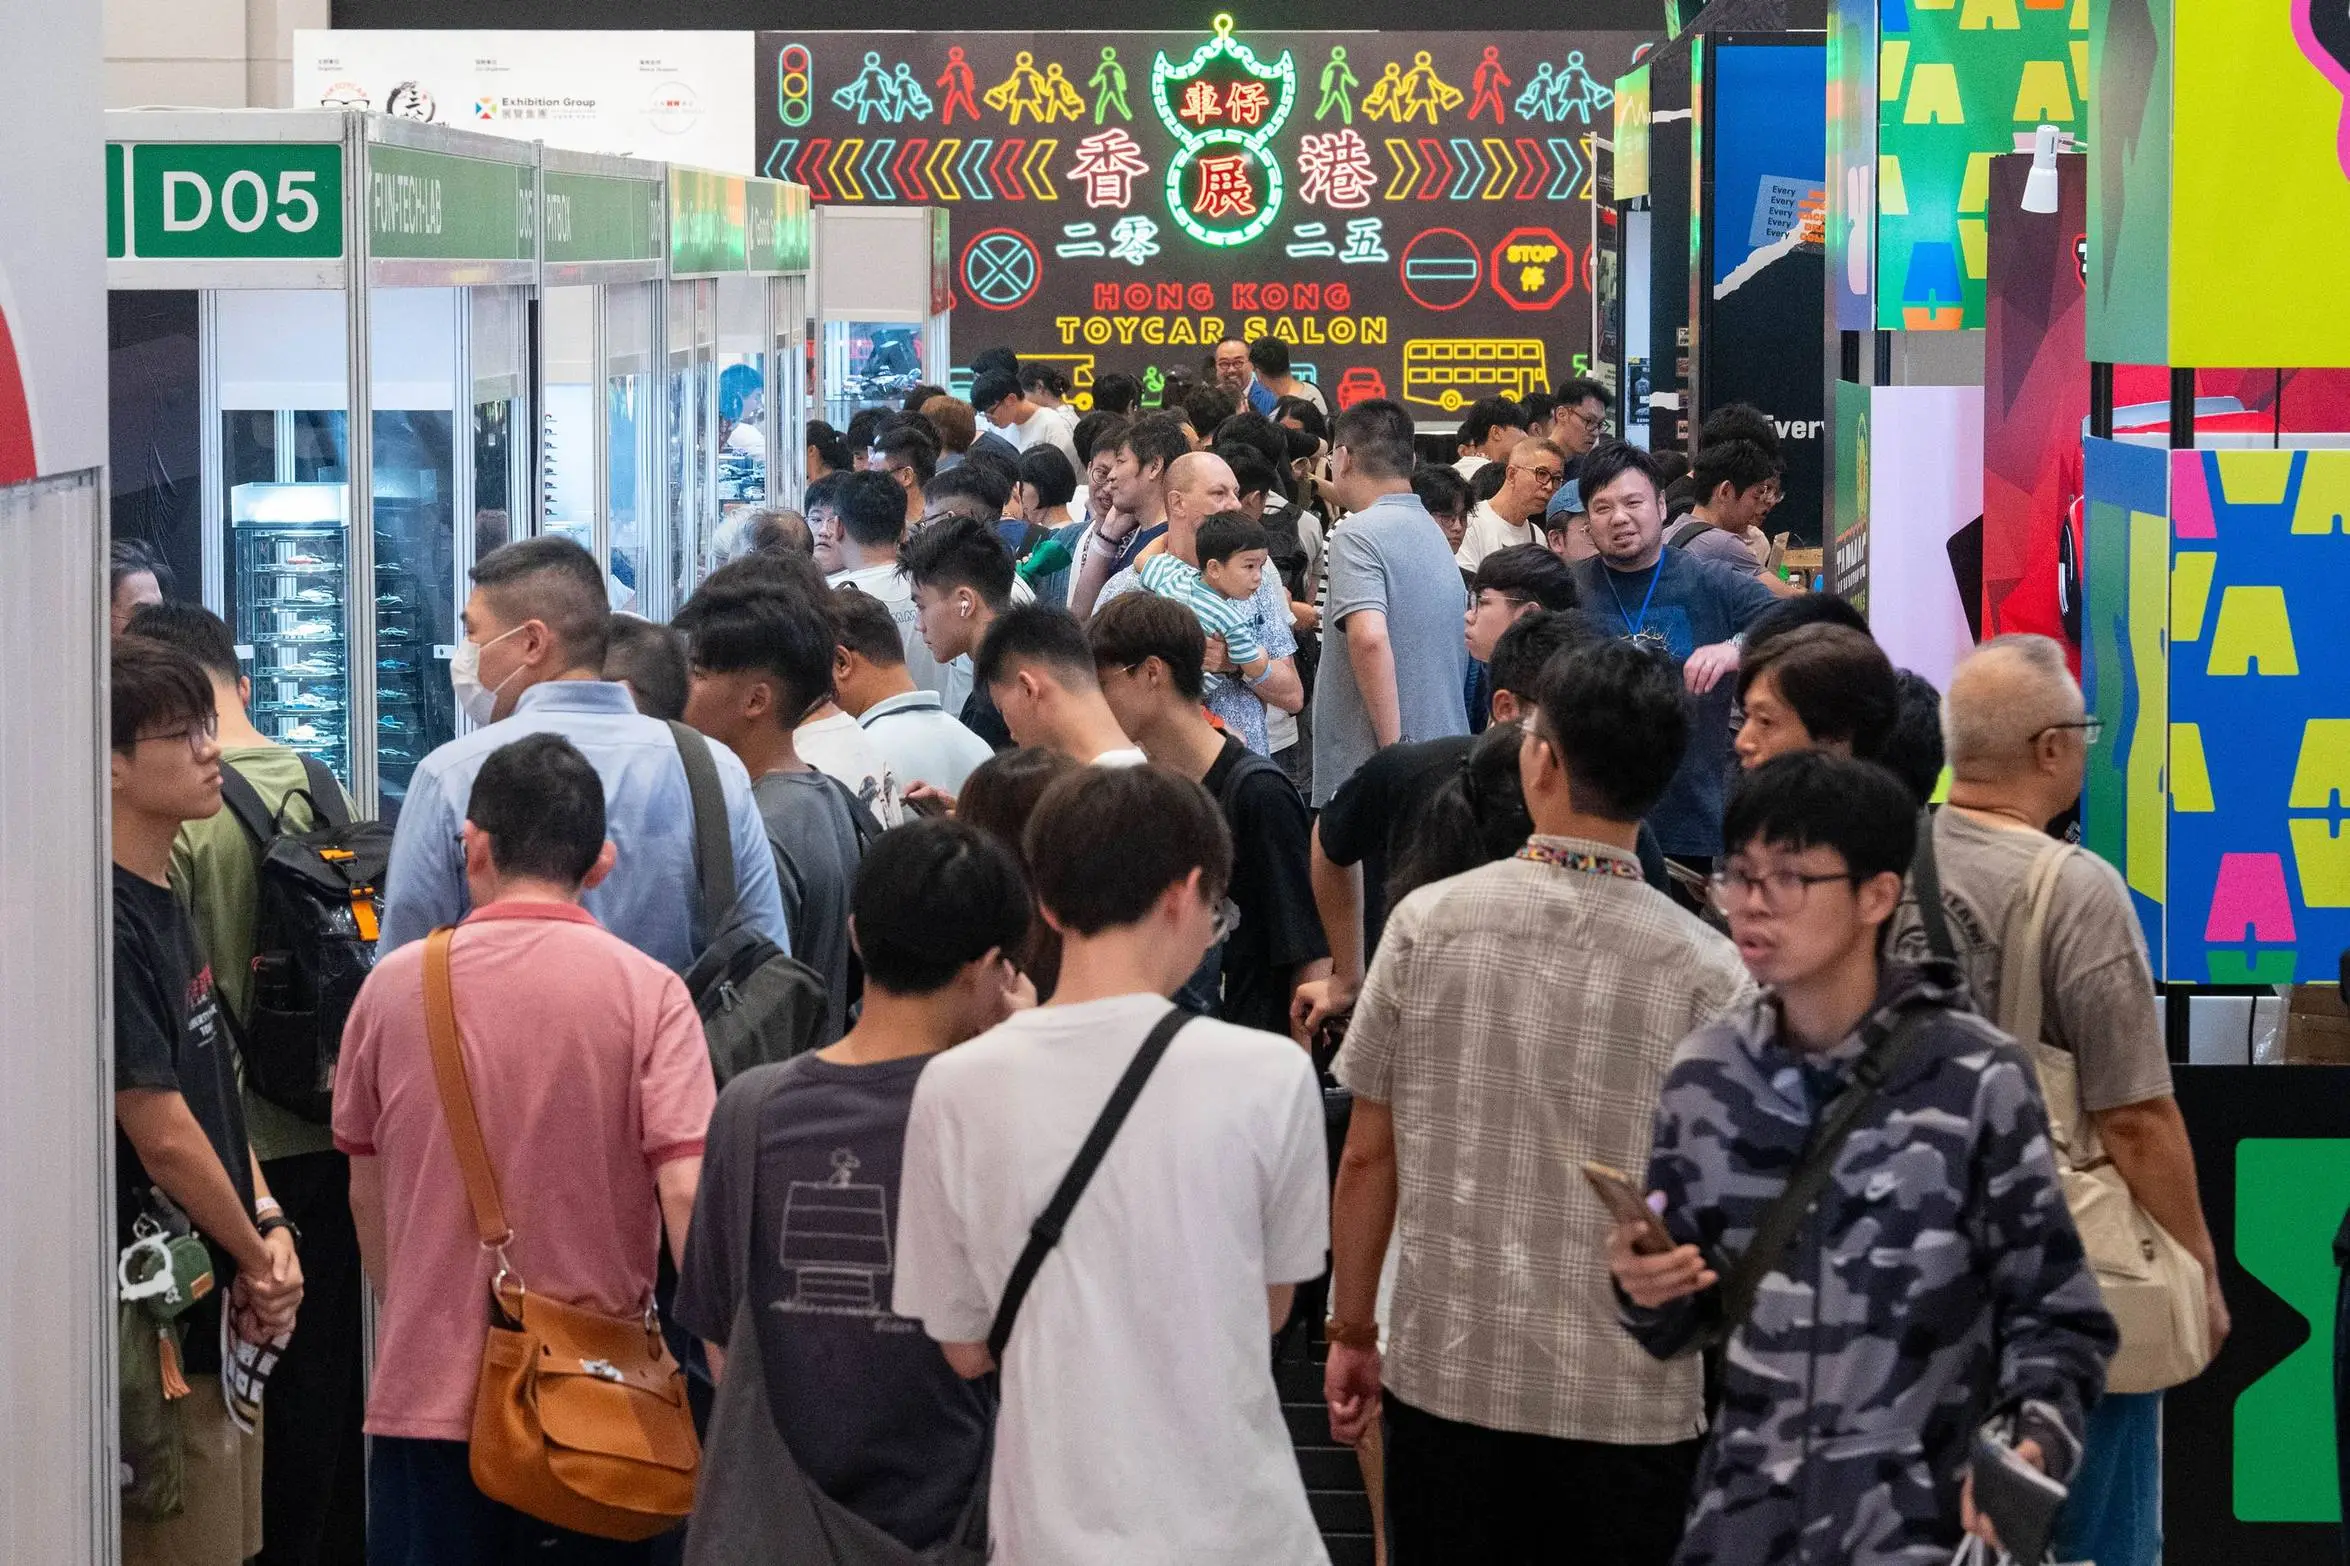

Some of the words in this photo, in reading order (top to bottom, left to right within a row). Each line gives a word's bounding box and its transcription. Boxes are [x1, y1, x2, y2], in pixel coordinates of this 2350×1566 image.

[502, 97, 560, 107] Exhibition
[563, 97, 596, 108] Group
[1180, 81, 1270, 124] 車仔
[1066, 128, 1149, 209] 香
[1297, 128, 1378, 209] 港
[1193, 155, 1256, 218] 展
[1772, 185, 1796, 197] Every
[162, 170, 319, 233] D05
[374, 173, 442, 235] FUN-TECH-LAB
[1769, 207, 1793, 218] Every
[1770, 196, 1794, 207] Every
[1766, 228, 1790, 240] Every
[1767, 217, 1791, 229] Every
[1056, 215, 1160, 266] 二零
[1286, 217, 1389, 264] 二五
[1507, 245, 1558, 263] STOP
[1093, 283, 1214, 311] HONG
[1231, 283, 1351, 311] KONG
[1056, 316, 1225, 345] TOYCAR
[1244, 316, 1388, 345] SALON
